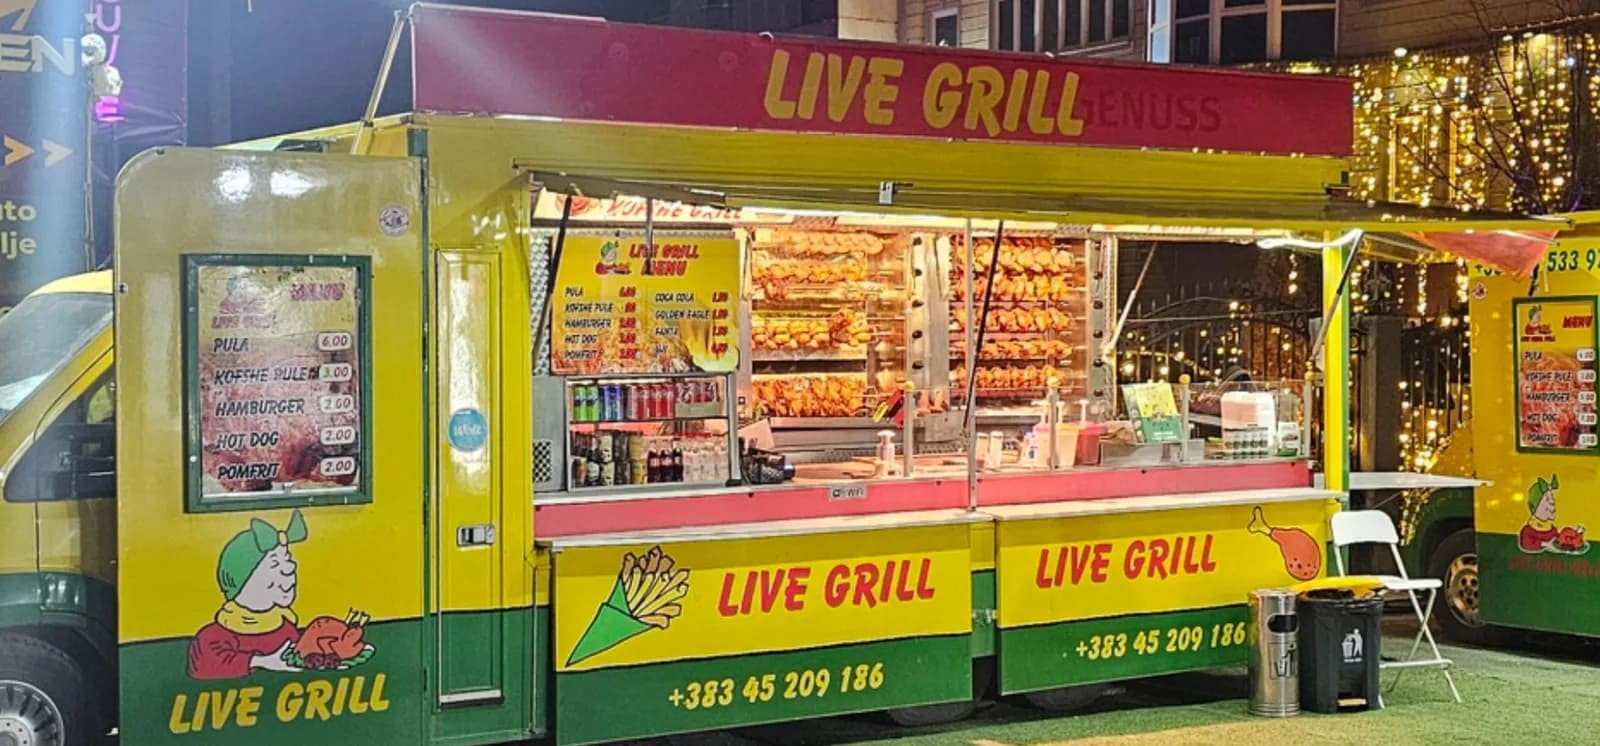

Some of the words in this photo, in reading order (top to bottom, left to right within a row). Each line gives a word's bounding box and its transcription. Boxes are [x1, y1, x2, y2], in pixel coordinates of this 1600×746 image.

[763, 49, 904, 126] LIVE
[922, 62, 1085, 138] GRILL
[1547, 250, 1579, 272] 533
[1586, 248, 1600, 271] 9
[213, 337, 249, 353] PULA
[321, 335, 349, 348] 6.00
[214, 367, 269, 385] KOFSHE
[272, 366, 308, 382] PULE
[215, 400, 305, 416] HAMBURGER
[325, 398, 351, 410] 2.00
[217, 434, 245, 449] HOT
[250, 431, 279, 447] DOG
[325, 428, 352, 441] 2.00
[217, 462, 280, 480] POMFRIT
[324, 459, 352, 473] 2.00
[1035, 543, 1113, 590] LIVE
[1122, 533, 1217, 582] GRILL
[717, 566, 811, 618] LIVE
[824, 557, 935, 608] GRILL
[1075, 631, 1127, 661] +383
[1133, 629, 1160, 655] 45
[1166, 626, 1203, 653] 209
[1210, 621, 1246, 647] 186
[668, 677, 734, 710] +383
[742, 674, 776, 703] 45
[784, 669, 832, 700] 209
[840, 662, 885, 693] 186
[168, 686, 264, 734] LIVE
[275, 673, 390, 722] GRILL
